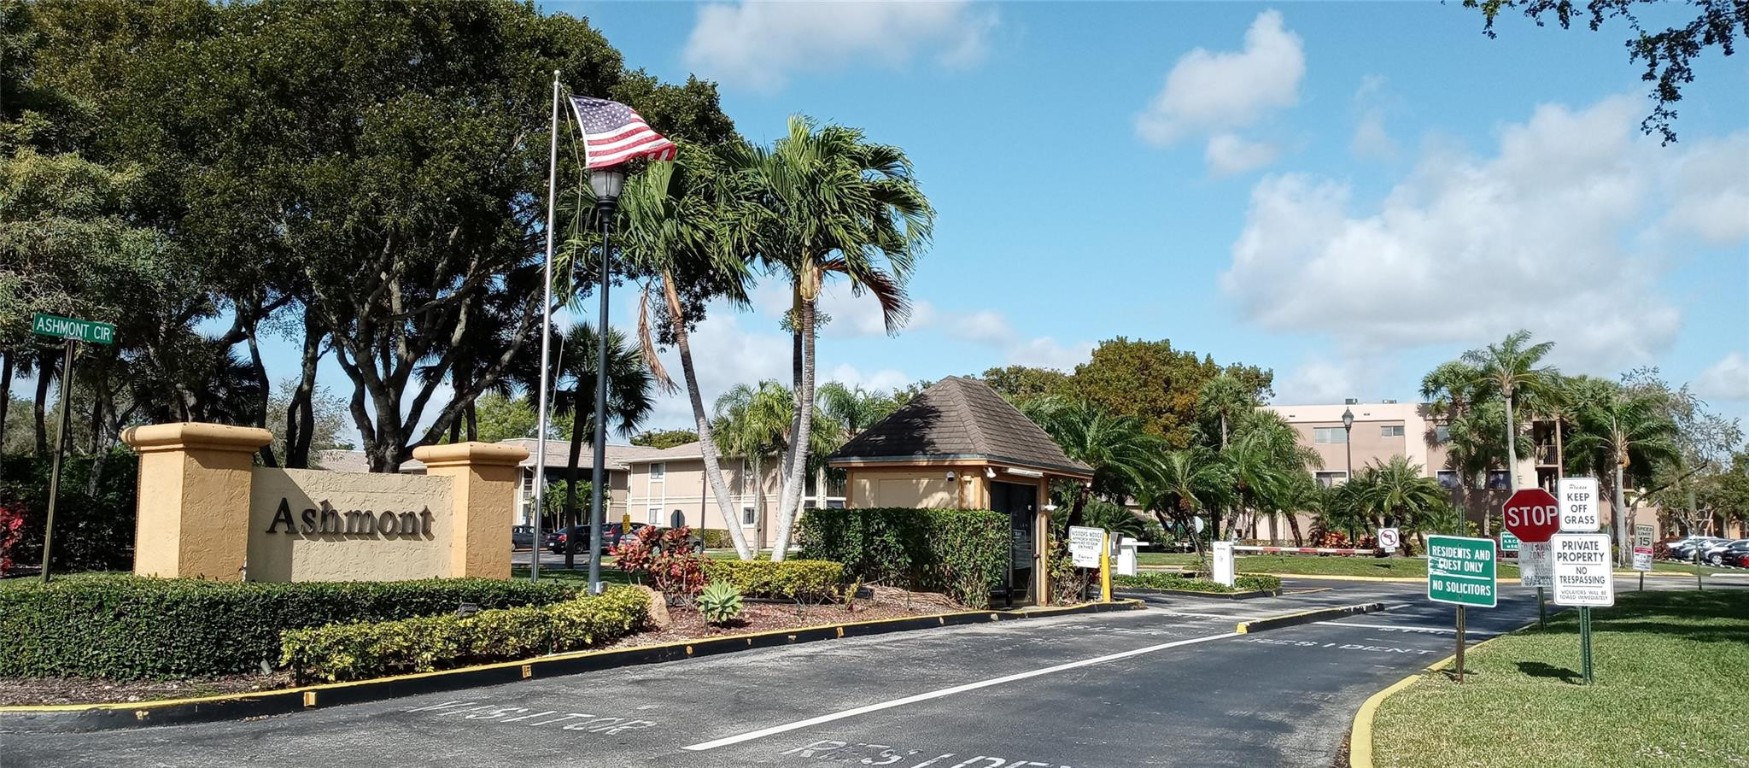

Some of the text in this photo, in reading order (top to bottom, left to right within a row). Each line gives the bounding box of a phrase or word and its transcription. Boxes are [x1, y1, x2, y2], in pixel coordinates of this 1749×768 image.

[36, 317, 111, 341] ASHMONT CIR
[1567, 493, 1590, 501] KEEP
[1570, 504, 1588, 513] OFF
[265, 497, 433, 535] Ashmont
[1508, 505, 1558, 527] STOP
[1564, 515, 1595, 524] GRASS
[1562, 541, 1599, 550] PRIVATE
[1639, 537, 1650, 546] 15
[1432, 546, 1491, 561] RESIDENTS AND
[1557, 552, 1605, 562] PROPERTY
[1464, 561, 1483, 573] ONLY
[1576, 566, 1587, 575] NO
[1560, 576, 1606, 584] TRESPASSING
[1432, 580, 1491, 596] NO SOLICITORS
[406, 700, 658, 735] VISITOR
